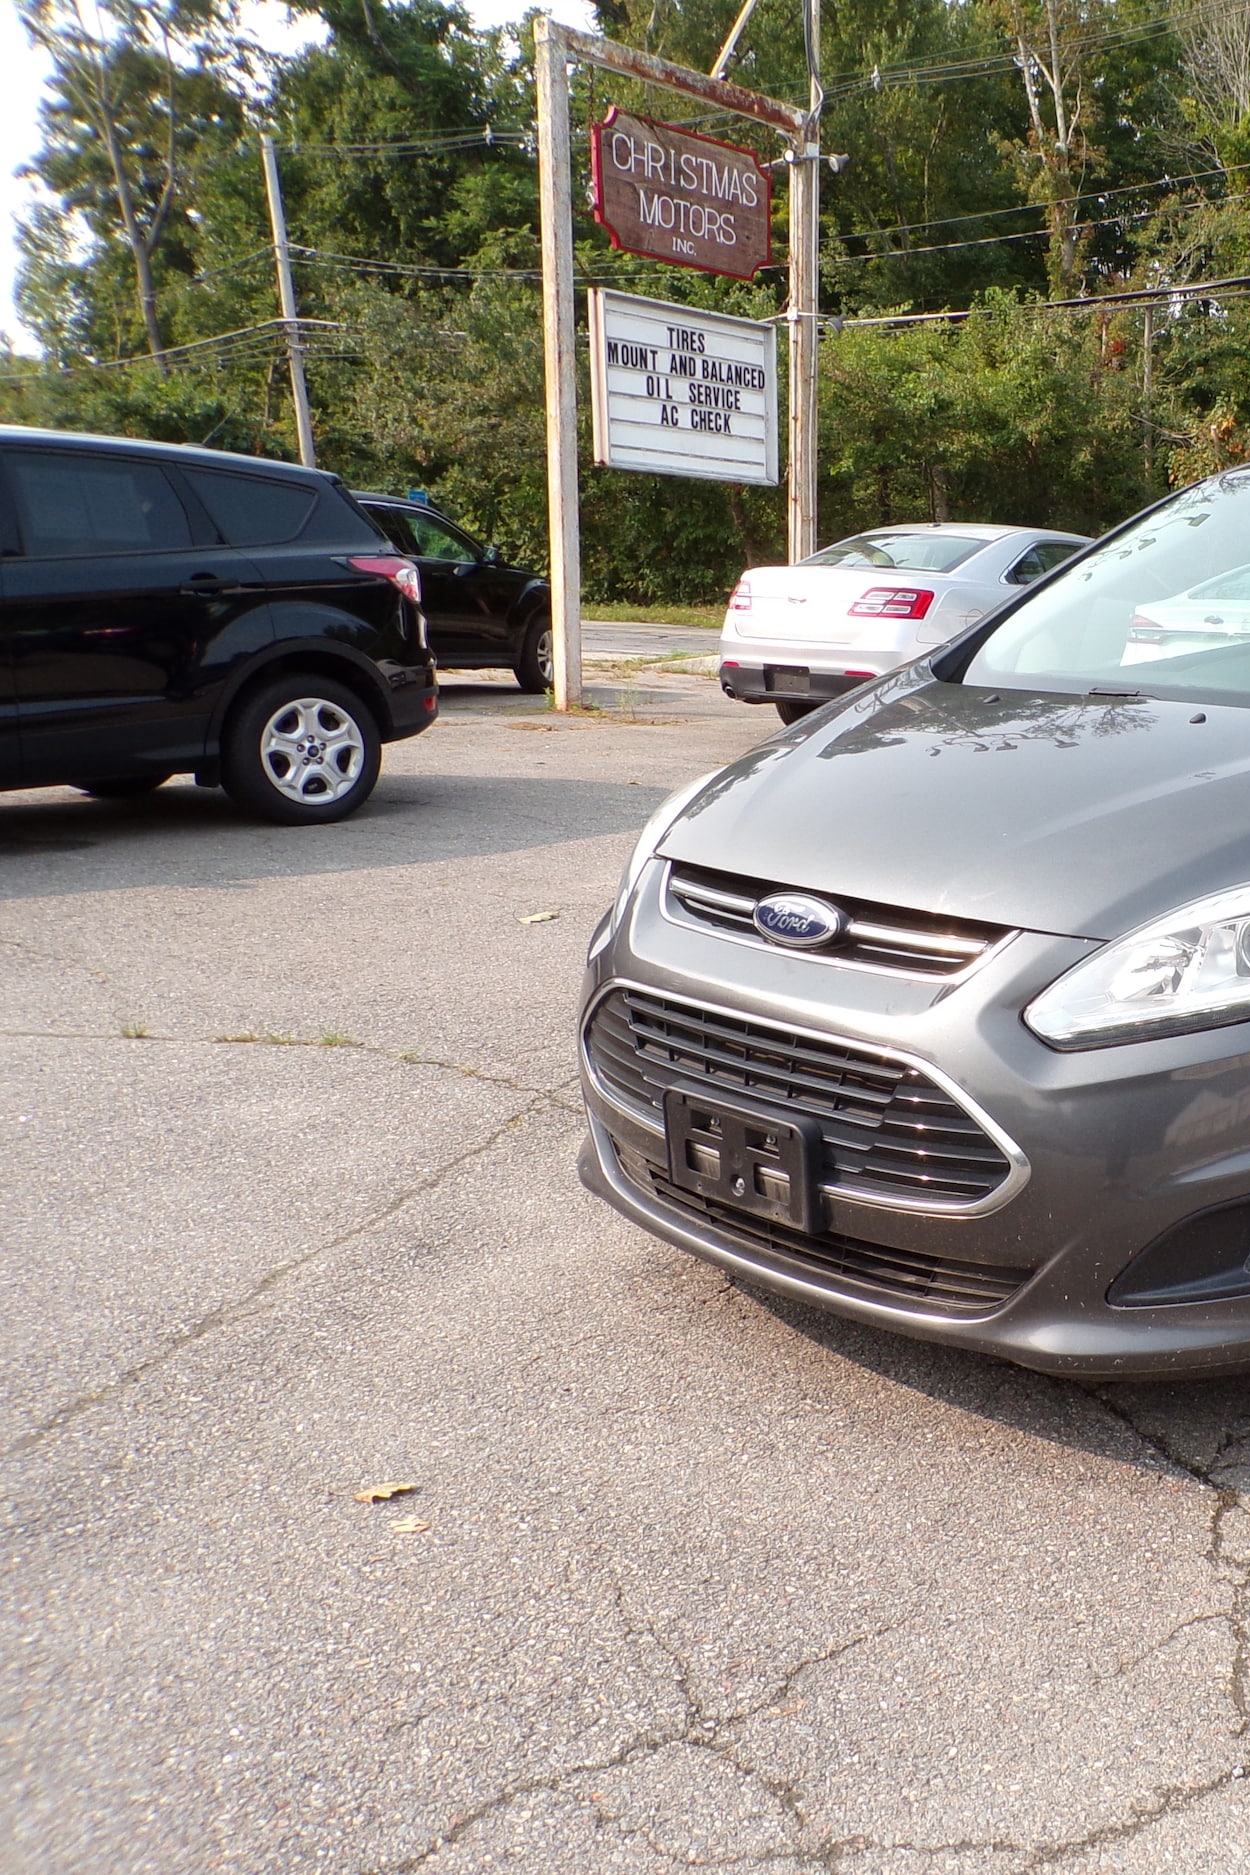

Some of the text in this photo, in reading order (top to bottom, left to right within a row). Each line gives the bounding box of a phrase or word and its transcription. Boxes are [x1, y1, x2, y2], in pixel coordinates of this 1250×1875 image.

[612, 133, 758, 207] CHRISTMAS
[639, 188, 737, 245] MOTORS
[672, 236, 697, 256] INC.
[666, 326, 706, 354] TIRES
[607, 341, 766, 390] MOUNT AND BALANCED
[646, 375, 742, 411] OIL SERVICE
[660, 403, 732, 434] AC CHECK
[767, 902, 815, 934] Ford
